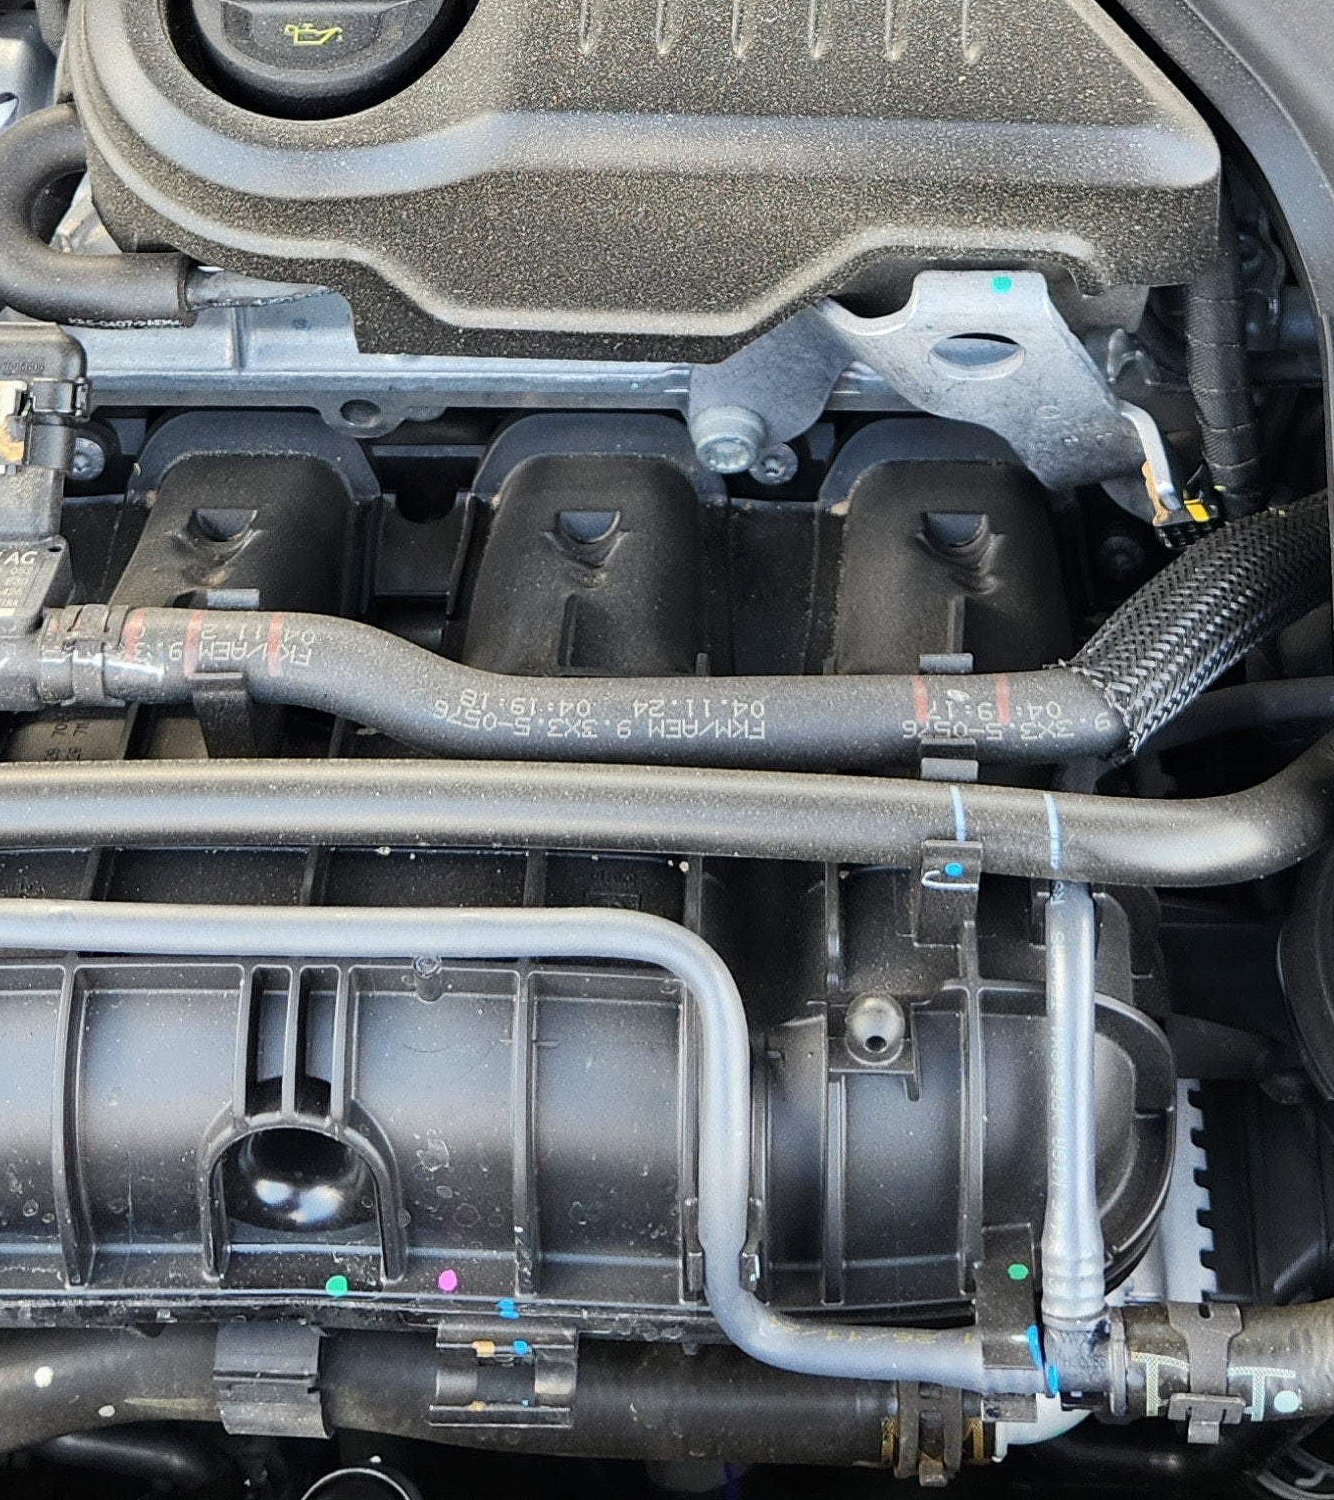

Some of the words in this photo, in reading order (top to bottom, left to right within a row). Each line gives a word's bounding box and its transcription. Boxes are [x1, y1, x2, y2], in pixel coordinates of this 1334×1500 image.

[3, 550, 38, 565] AG
[188, 623, 316, 646] 0411.2
[457, 687, 592, 718] 04:19:18
[632, 696, 766, 718] 04.11.24
[924, 699, 1062, 722] 04:9:17
[647, 718, 766, 740] FKM/AEM
